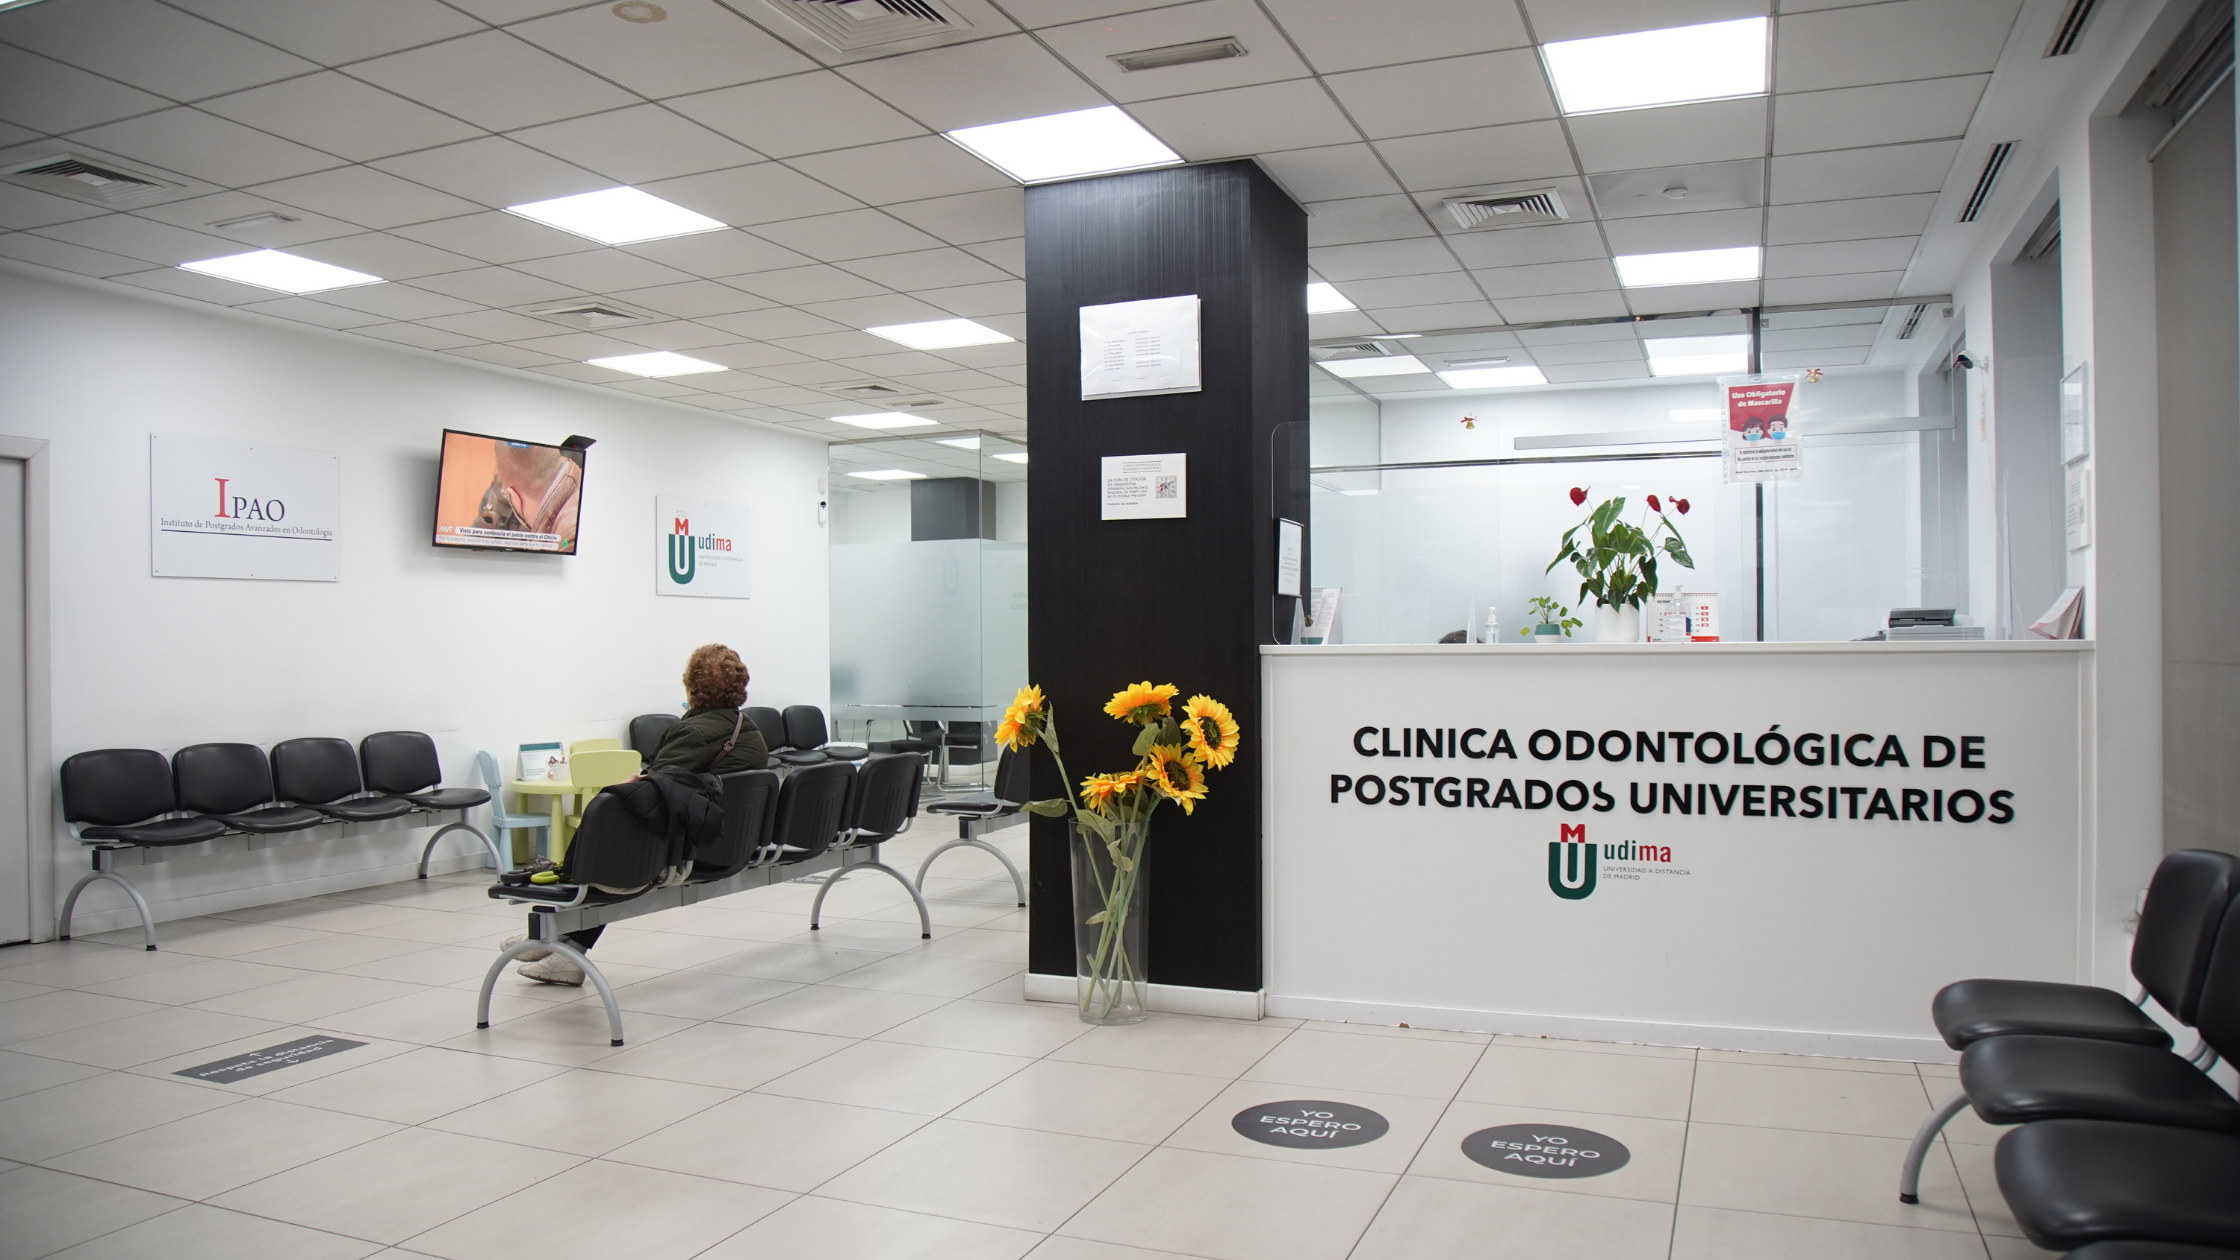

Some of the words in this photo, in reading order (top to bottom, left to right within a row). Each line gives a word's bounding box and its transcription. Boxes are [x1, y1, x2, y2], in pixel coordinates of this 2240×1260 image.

[1746, 390, 1786, 398] Obligatorio
[1748, 398, 1782, 406] Mascarilla
[214, 478, 285, 522] IPAO
[160, 518, 193, 528] Instituto
[195, 520, 203, 528] de
[205, 521, 244, 532] Postgrados
[245, 524, 281, 533] Avanzados
[699, 533, 731, 551] udima
[1354, 726, 1518, 759] CLINICA
[1528, 724, 1909, 767] ODONTOLÓGICA
[1923, 735, 1986, 769] DE
[1331, 774, 1615, 812] POSTGRADOS
[1630, 782, 2015, 824] UNIVERSITARIOS
[1604, 840, 1671, 862] udima
[1603, 866, 1647, 874] UNIVERSIDAD
[199, 1060, 258, 1076] Respeta
[275, 1039, 334, 1057] distancia
[256, 1047, 322, 1066] seguridad
[1301, 1110, 1334, 1119] YO
[1260, 1115, 1362, 1130] ESPERO
[1269, 1126, 1340, 1138] AQUÍ
[1532, 1134, 1568, 1145] YO
[1491, 1140, 1600, 1158] ESPERO
[1504, 1153, 1578, 1166] AQUÍ
